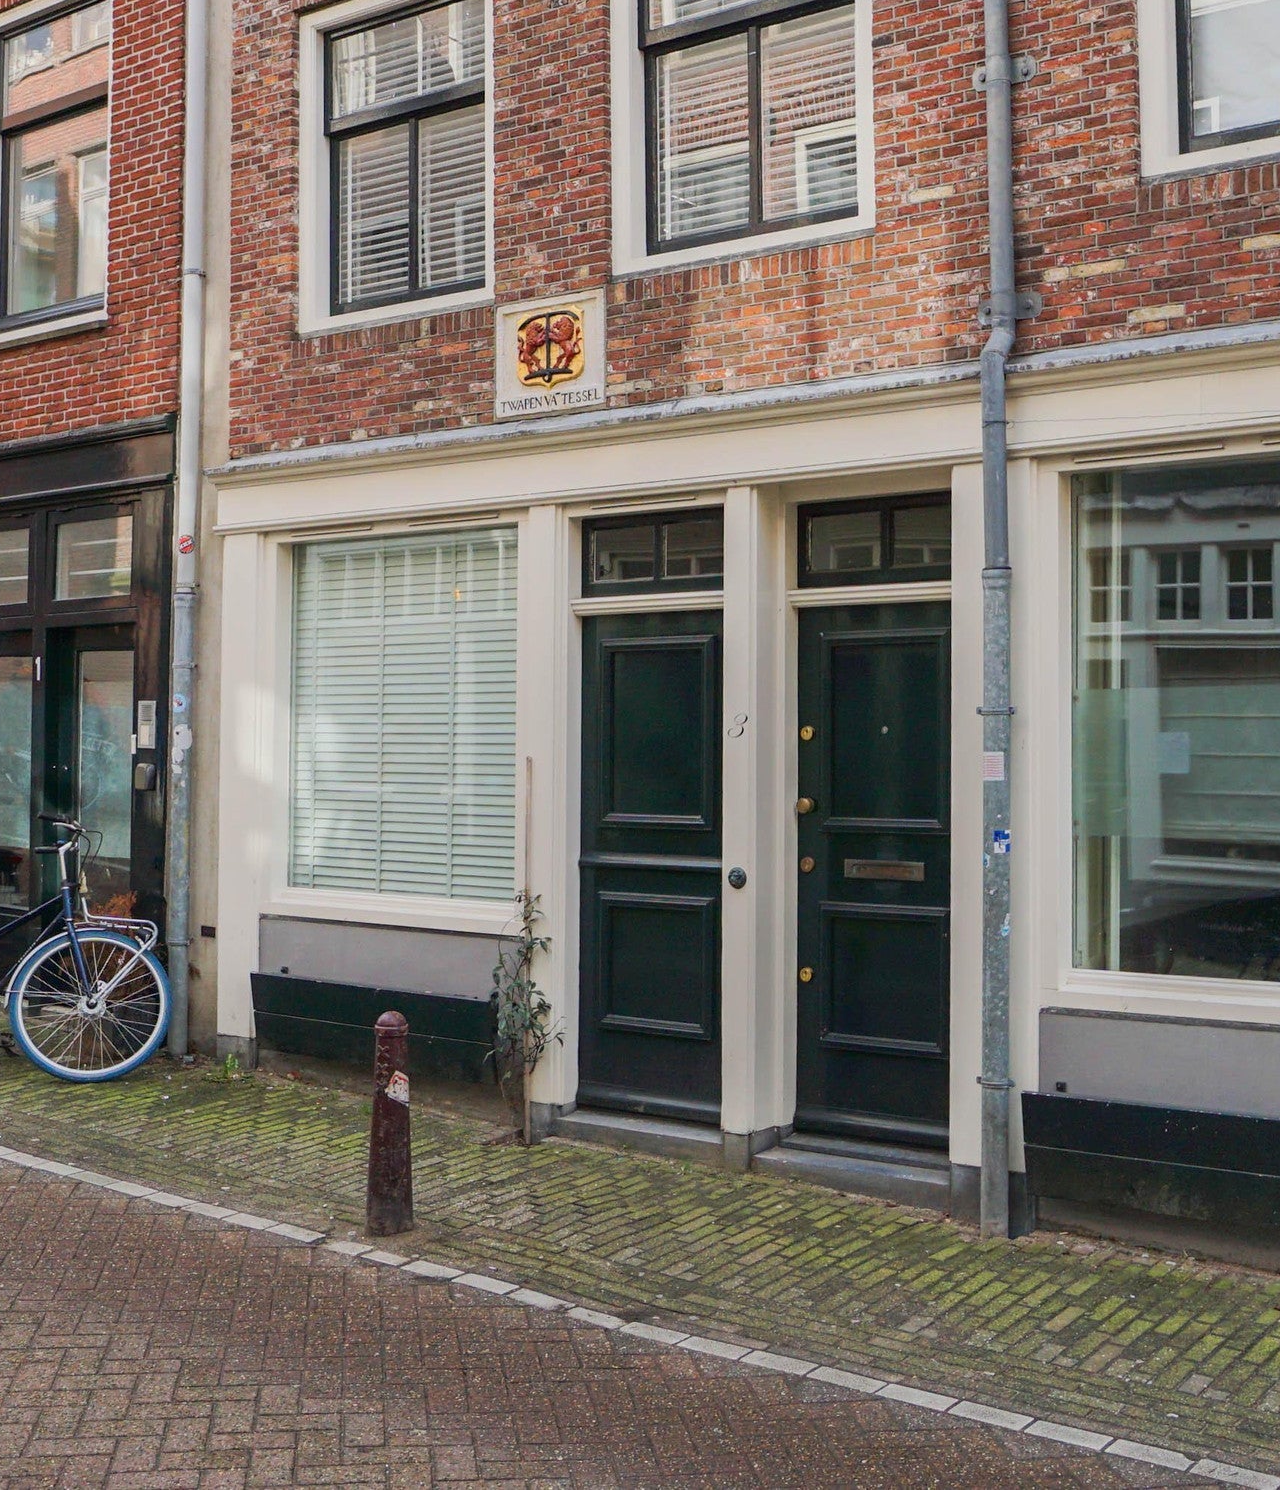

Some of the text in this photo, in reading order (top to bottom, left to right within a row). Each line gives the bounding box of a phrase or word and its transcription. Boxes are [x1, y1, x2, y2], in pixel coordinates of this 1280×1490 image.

[561, 388, 602, 405] TESSEL
[35, 656, 41, 681] 1
[727, 712, 749, 739] 3
